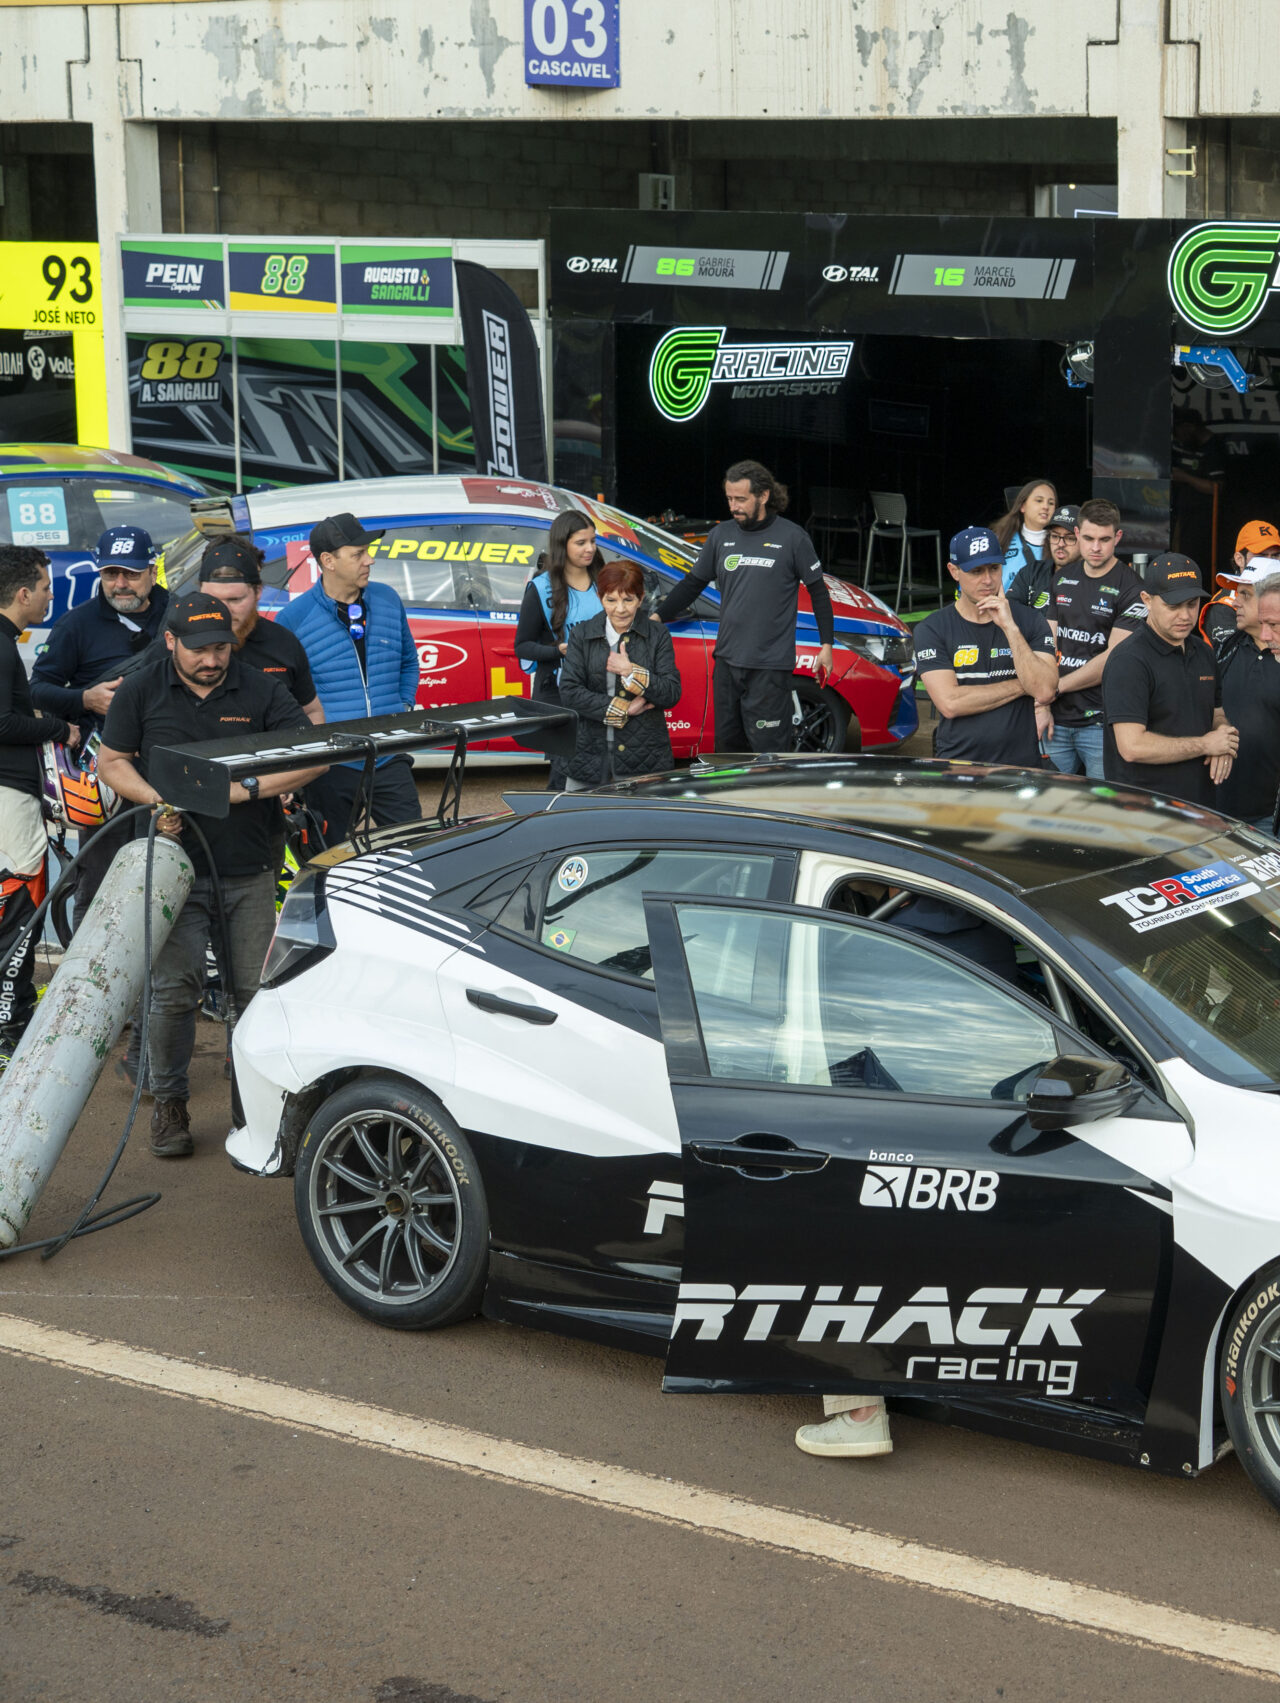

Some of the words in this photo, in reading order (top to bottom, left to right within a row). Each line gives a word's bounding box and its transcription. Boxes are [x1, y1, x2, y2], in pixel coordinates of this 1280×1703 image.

[531, 0, 608, 58] 03
[529, 60, 611, 79] CASCAVEL
[591, 258, 617, 269] TAI
[656, 257, 696, 277] 86
[698, 256, 736, 268] GABRIEL
[974, 265, 1015, 278] MARCEL
[42, 254, 94, 303] 93
[145, 263, 204, 283] PEIN
[261, 255, 309, 294] 88
[364, 267, 418, 284] AUGUSTO
[698, 266, 735, 278] MOURA
[850, 266, 879, 278] TAI
[933, 267, 966, 287] 16
[973, 276, 1016, 288] JORAND
[371, 285, 430, 301] SANGALLI
[33, 306, 60, 323] JOSÉ
[65, 311, 96, 325] NETO
[140, 341, 222, 380] 88
[716, 344, 848, 379] RACING
[158, 381, 220, 401] SANGALLI
[489, 319, 513, 477] POWER
[731, 382, 841, 399] MOTORSPORT
[19, 503, 57, 525] 88
[36, 531, 61, 541] SEG
[110, 540, 135, 555] 88
[969, 538, 990, 556] 88
[917, 648, 937, 658] PEIN
[954, 648, 979, 667] 88
[1182, 867, 1219, 885] South
[1192, 873, 1242, 895] America
[1099, 877, 1201, 920] TCR
[1136, 913, 1175, 930] TOURING
[1175, 907, 1193, 918] CAR
[1190, 890, 1240, 912] CHAMPIONSHIP
[868, 1149, 914, 1163] banco
[908, 1168, 1000, 1211] BRB
[905, 1346, 1078, 1396] racing
